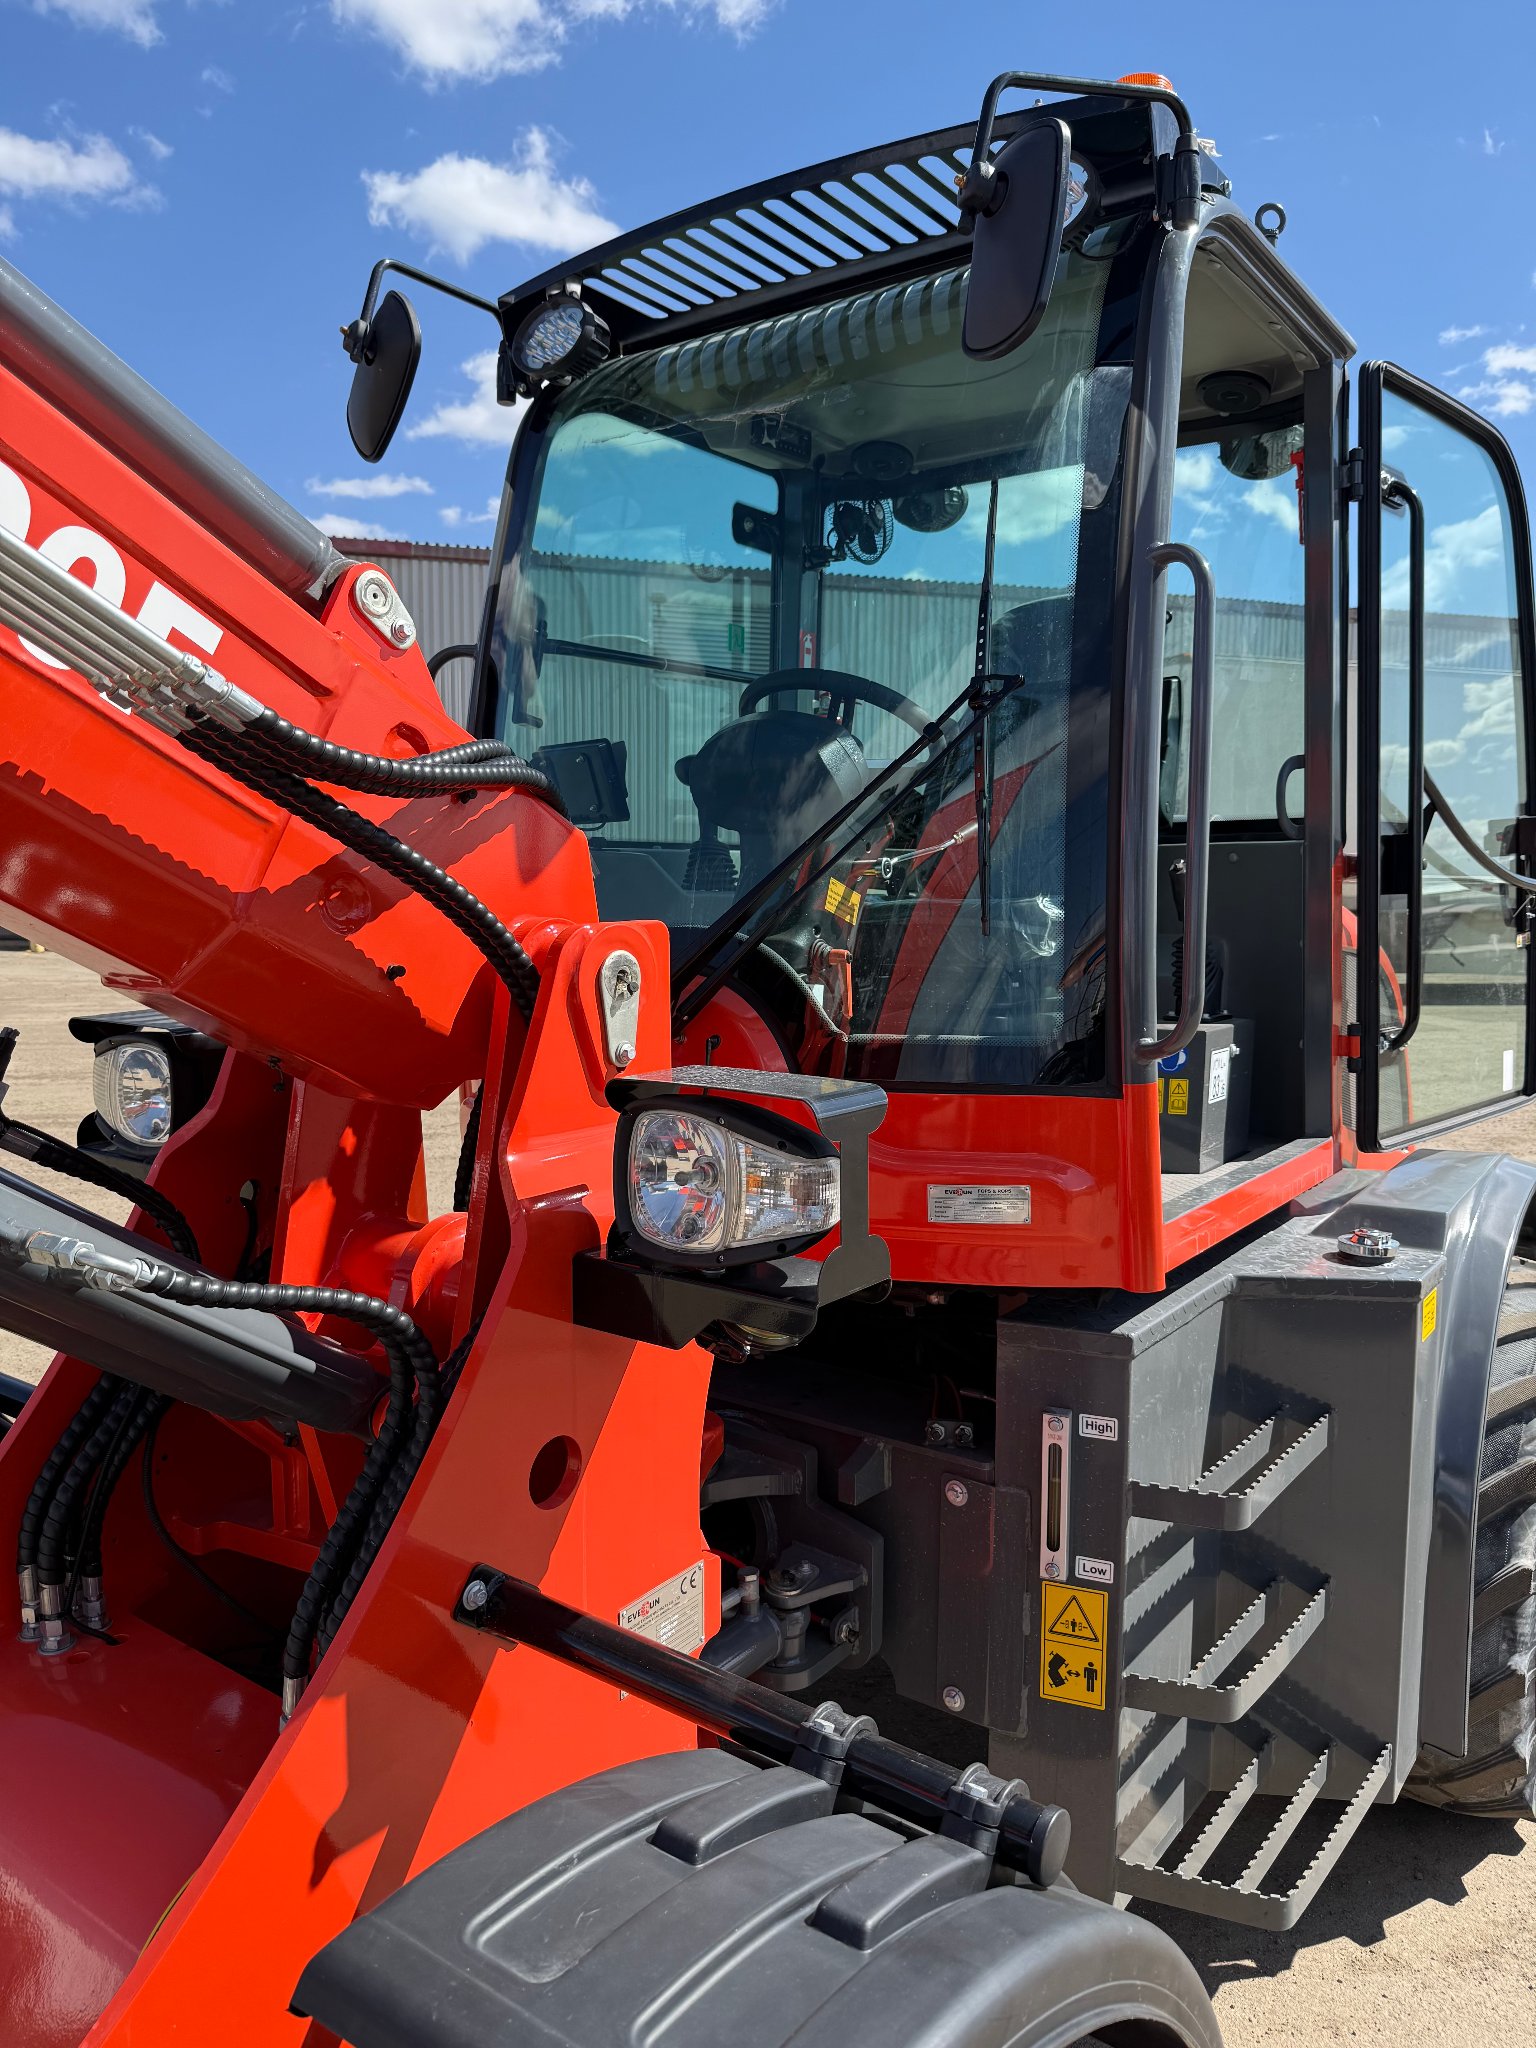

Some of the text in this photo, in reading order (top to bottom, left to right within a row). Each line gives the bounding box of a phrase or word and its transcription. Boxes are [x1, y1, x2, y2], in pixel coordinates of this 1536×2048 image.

[944, 1188, 973, 1197] EVERUN
[1085, 1420, 1113, 1434] High
[1083, 1562, 1107, 1576] Low
